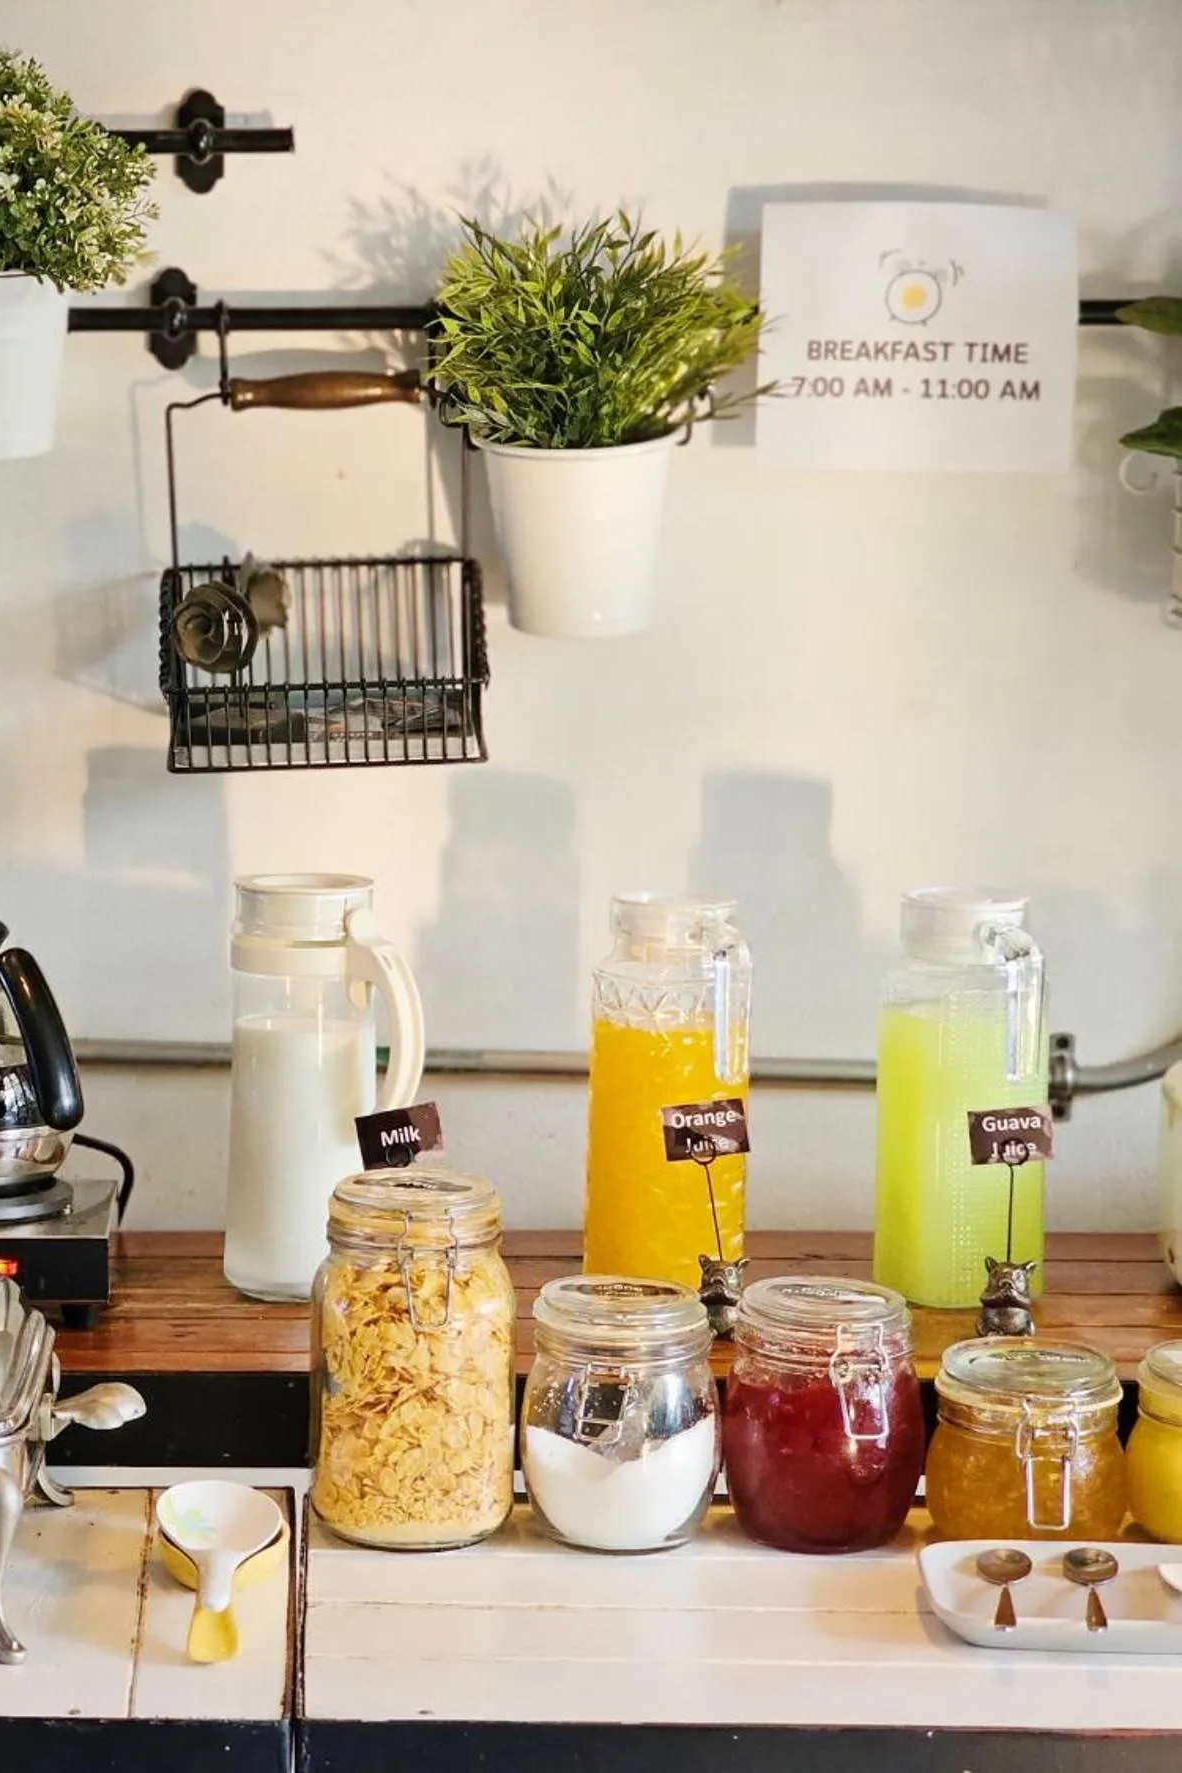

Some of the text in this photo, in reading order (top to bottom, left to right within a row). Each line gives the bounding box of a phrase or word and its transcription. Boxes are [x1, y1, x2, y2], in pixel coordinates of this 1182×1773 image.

[807, 340, 1029, 364] BREAKFAST TIME
[791, 376, 845, 398] 7:00
[853, 377, 893, 398] AM
[921, 378, 990, 400] 11:00
[999, 379, 1040, 400] AM
[671, 1109, 737, 1129] Orange
[982, 1115, 1042, 1133] Guava
[380, 1125, 421, 1147] Milk
